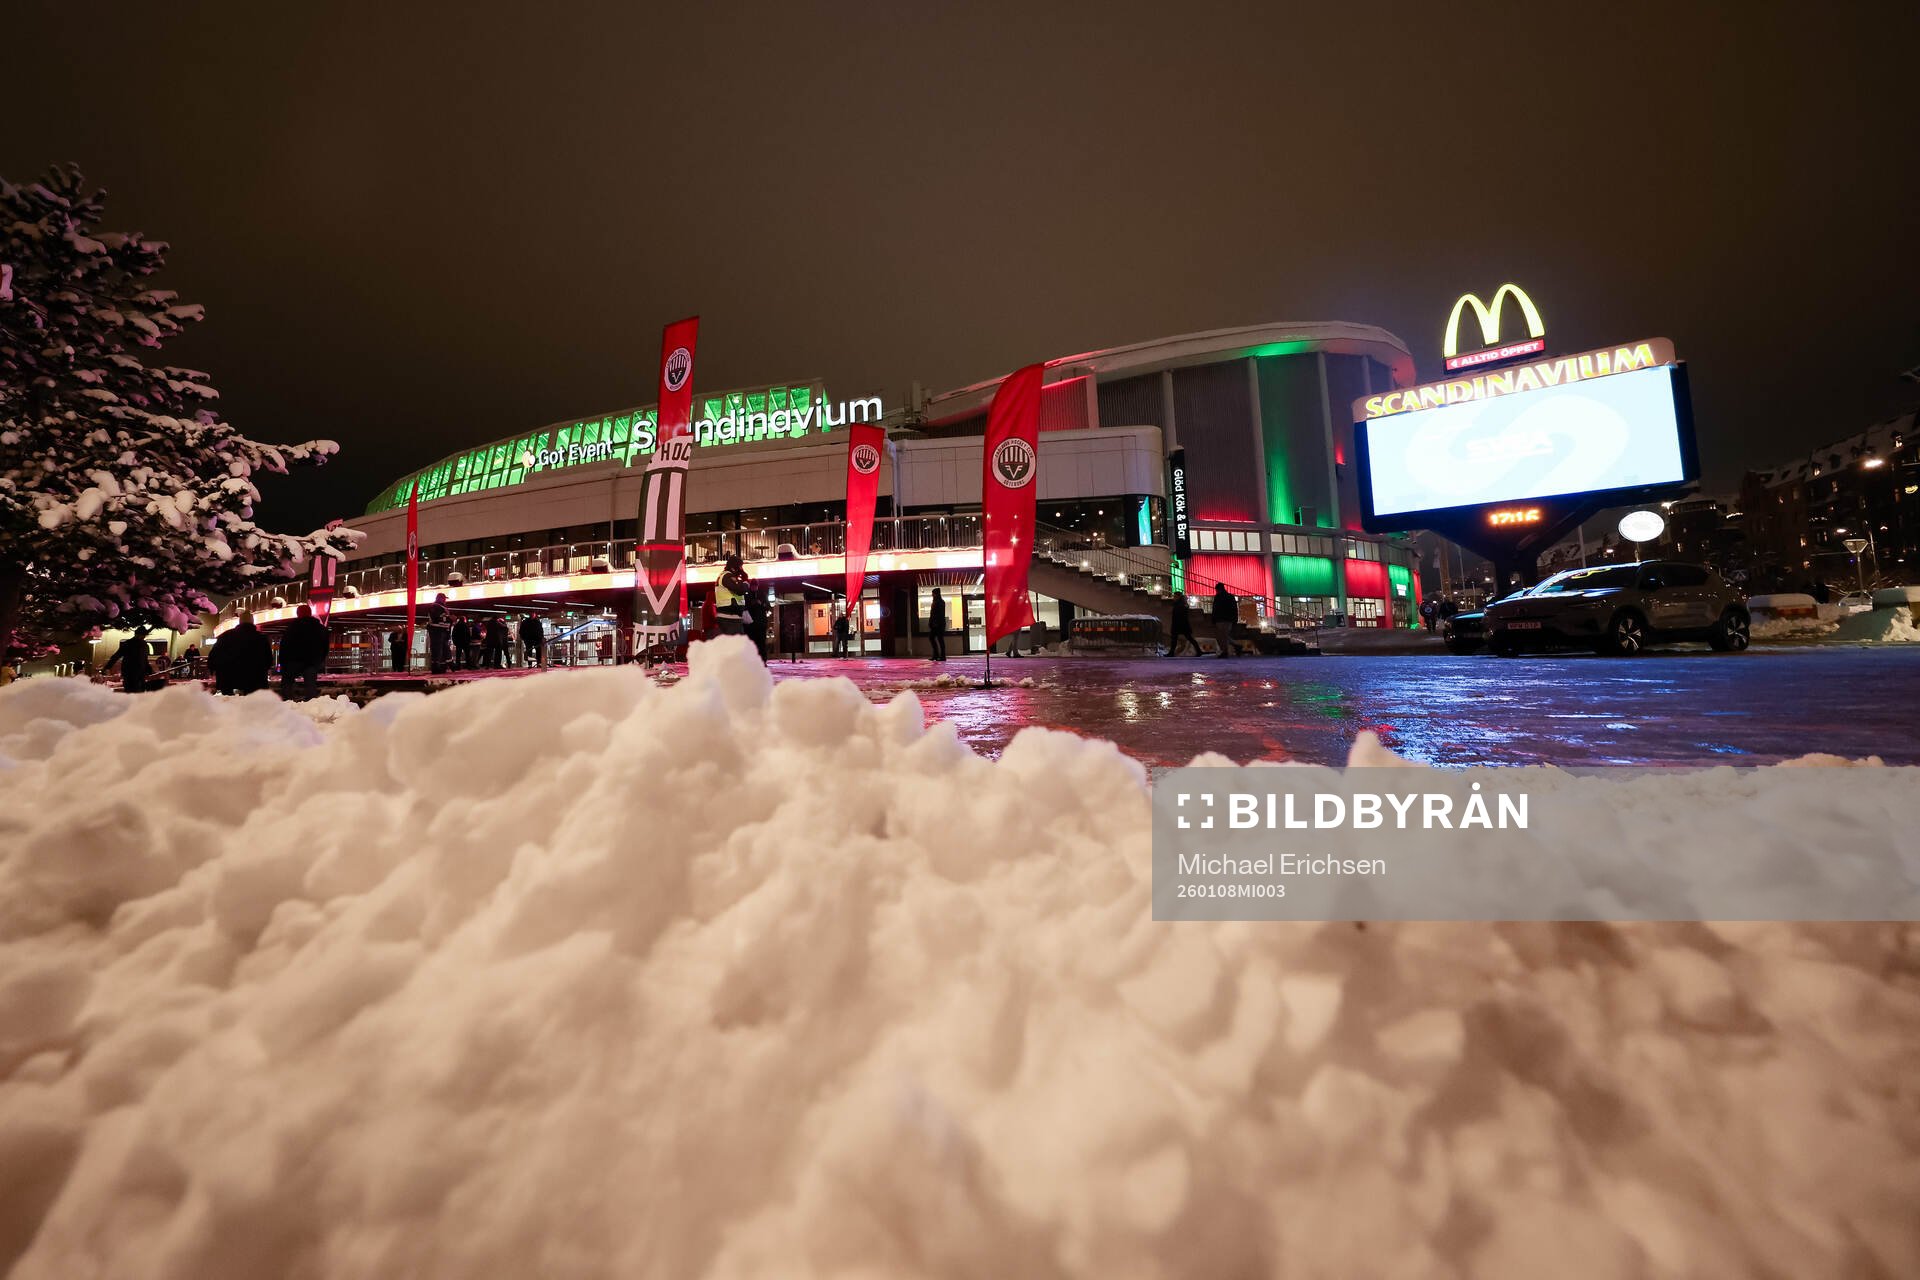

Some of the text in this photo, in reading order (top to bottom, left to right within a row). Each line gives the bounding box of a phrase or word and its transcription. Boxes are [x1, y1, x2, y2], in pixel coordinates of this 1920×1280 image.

[1461, 342, 1539, 366] ALLTID ÖPPET
[1365, 343, 1656, 419] SCANDINAVIUM
[540, 437, 613, 465] Got Event
[1174, 469, 1188, 540] Glöd Kök & Bar
